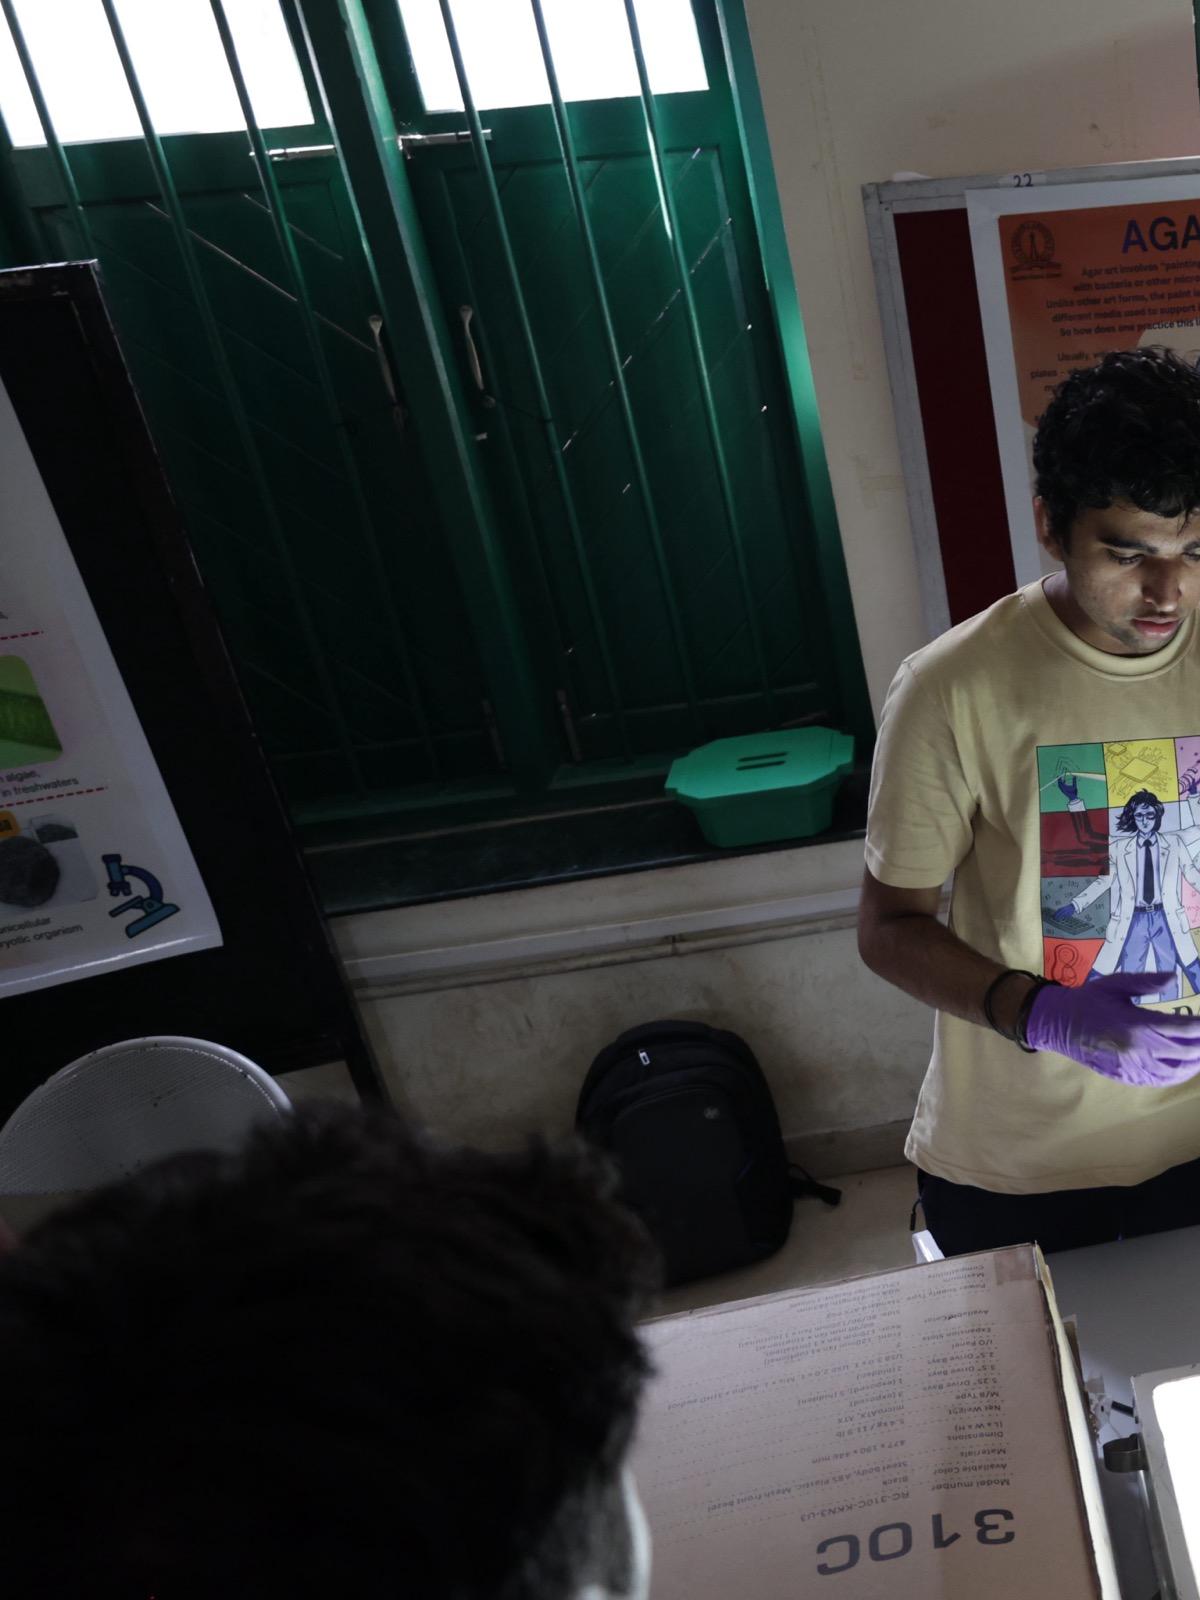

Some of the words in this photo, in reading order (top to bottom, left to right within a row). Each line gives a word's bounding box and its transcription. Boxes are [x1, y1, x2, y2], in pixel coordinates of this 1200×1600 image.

[1014, 173, 1034, 188] 22
[1094, 278, 1132, 289] bacteria
[1159, 302, 1195, 316] support
[1136, 319, 1174, 332] practice
[1176, 317, 1193, 327] this
[14, 778, 79, 794] freshwaters
[33, 924, 83, 940] organism
[984, 1404, 1000, 1412] Net
[946, 1431, 1003, 1442] Dimensions
[959, 1448, 1006, 1458] Materials
[932, 1467, 960, 1476] Color
[961, 1463, 1007, 1473] Available
[881, 1476, 907, 1486] Black
[975, 1478, 1010, 1488] Model
[816, 1508, 1015, 1576] 310C
